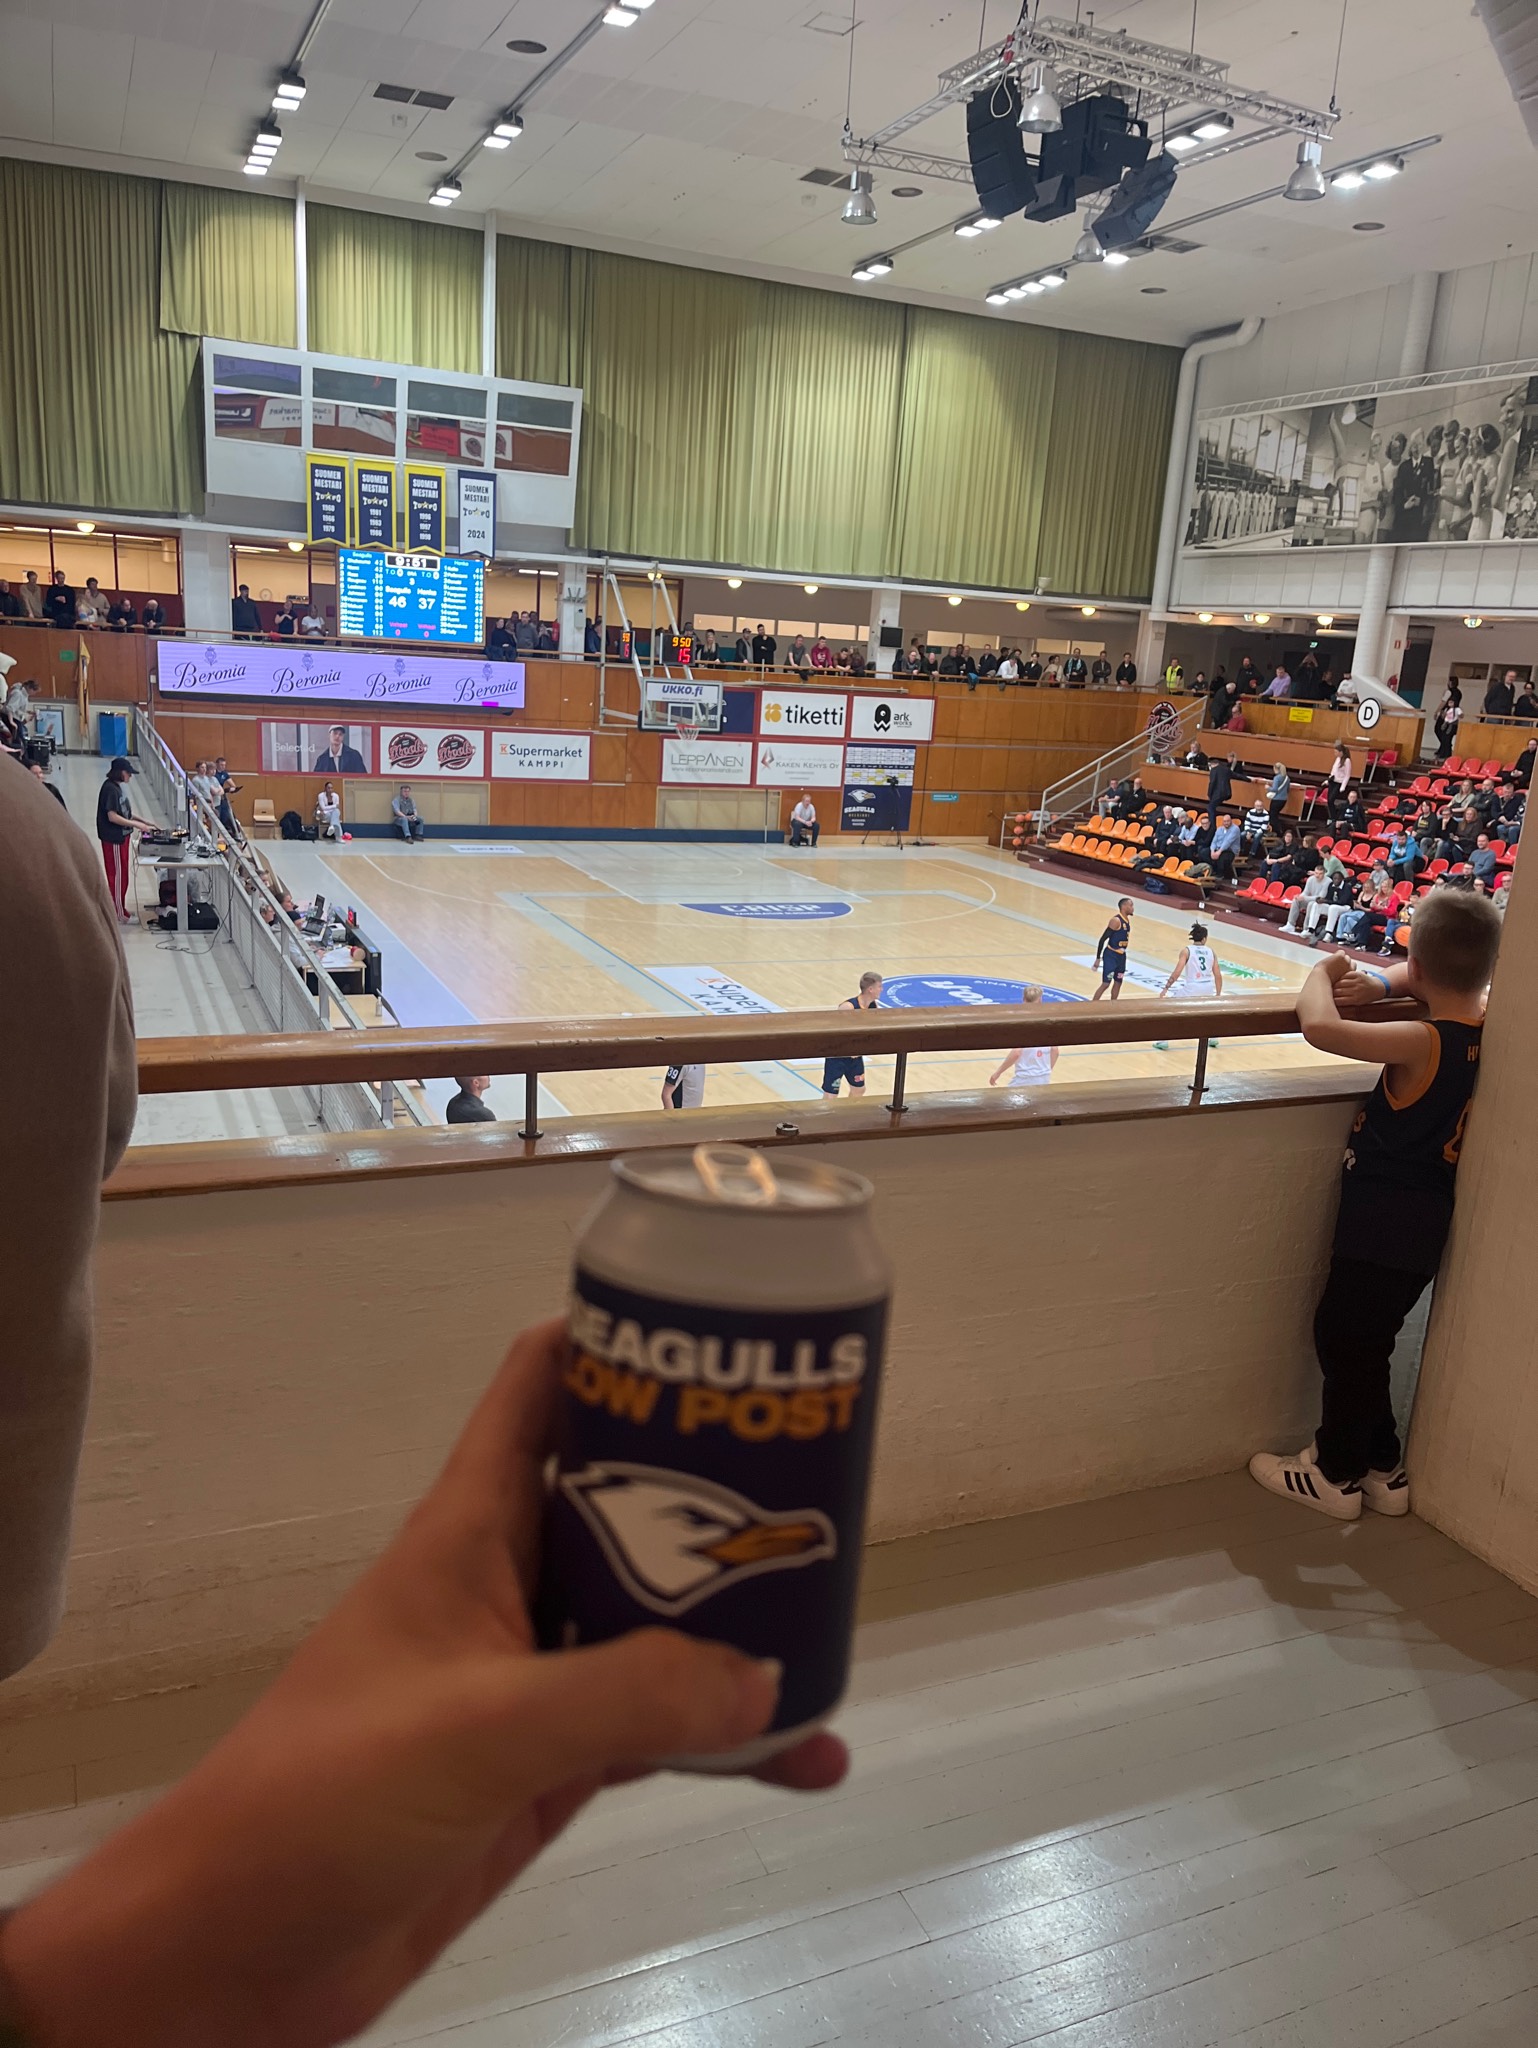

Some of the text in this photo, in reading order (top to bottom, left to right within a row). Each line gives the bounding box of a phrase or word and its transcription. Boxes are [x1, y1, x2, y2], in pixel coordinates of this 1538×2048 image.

[314, 468, 341, 480] SUOMEN
[361, 474, 388, 485] SUOMEN
[314, 478, 342, 490] MESTARI
[361, 483, 389, 495] MESTARI
[412, 478, 438, 490] SUOMEN
[464, 484, 489, 495] SUOMEN
[412, 488, 439, 499] MESTARI
[464, 493, 490, 504] MESTARI
[467, 529, 486, 539] 2024
[388, 595, 407, 608] 46
[418, 597, 436, 610] 37
[678, 648, 691, 664] 15
[172, 661, 247, 690] Beronia
[270, 667, 342, 694] Beronia
[364, 672, 432, 699] Beronia
[453, 677, 519, 703] Beronia
[662, 685, 704, 697] UKKO.fi
[785, 704, 844, 726] tiketti
[893, 712, 910, 721] ark
[1363, 706, 1374, 721] D
[274, 743, 315, 753] Selecd
[519, 760, 564, 768] KAMPPI
[1198, 956, 1206, 971] 3
[667, 1066, 679, 1080] 39
[675, 1382, 861, 1443] POST
